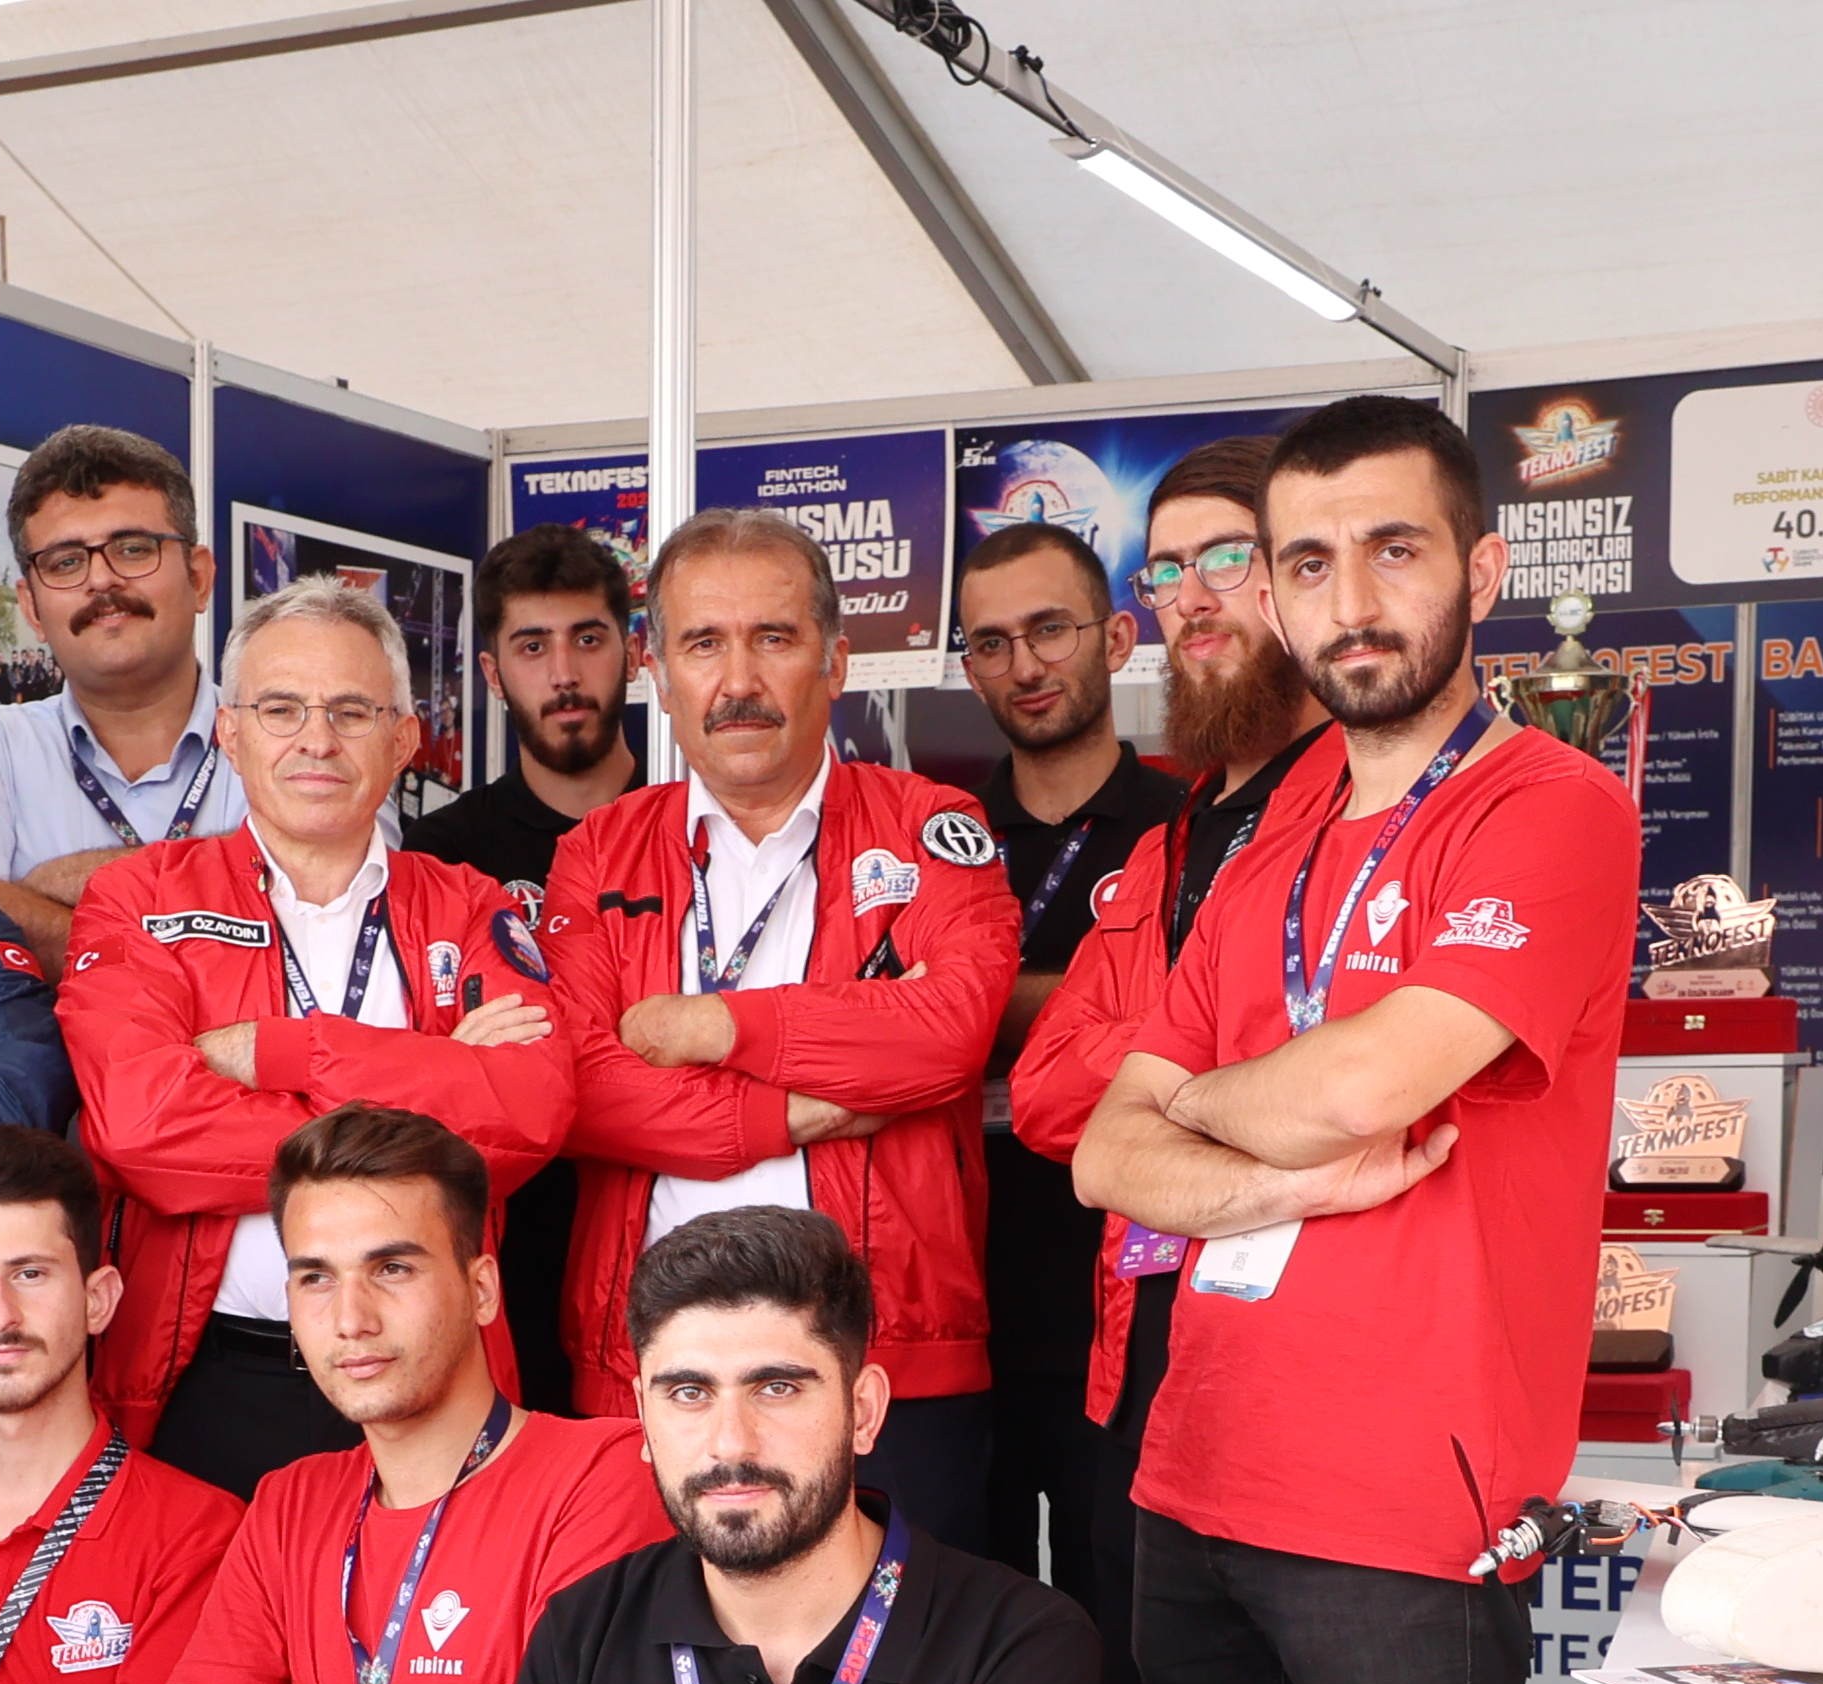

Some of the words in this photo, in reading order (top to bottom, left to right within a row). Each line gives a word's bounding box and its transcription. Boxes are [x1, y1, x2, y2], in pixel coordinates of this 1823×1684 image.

[1519, 433, 1617, 481] TEKNOFEST
[758, 479, 847, 498] IDEATHON
[1757, 468, 1799, 485] SABİT
[1509, 542, 1544, 567] AVA
[1318, 855, 1377, 968] TEKNOFEST
[191, 916, 259, 941] ÖZAYDIN
[1345, 951, 1399, 974] TÜBİTAK
[1619, 1115, 1744, 1157] TEKNOFEST
[409, 1656, 464, 1675] TÜBİTAK
